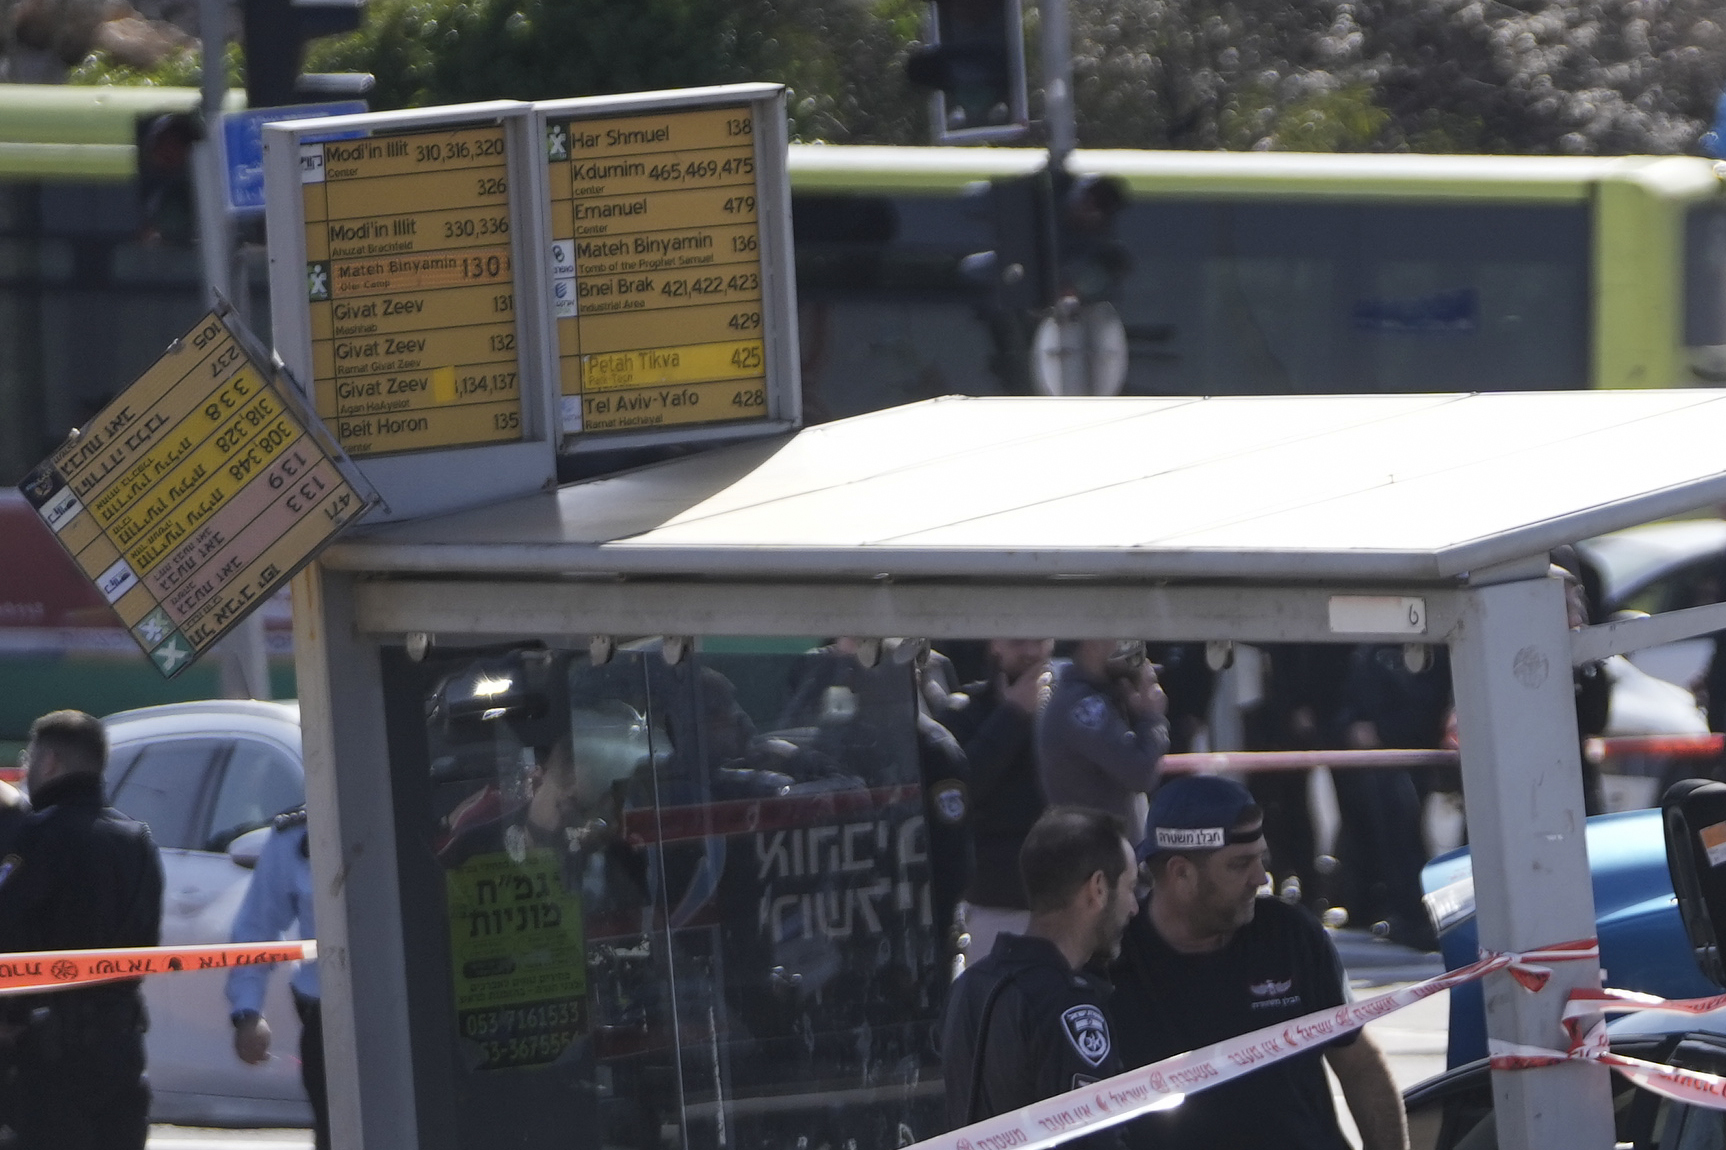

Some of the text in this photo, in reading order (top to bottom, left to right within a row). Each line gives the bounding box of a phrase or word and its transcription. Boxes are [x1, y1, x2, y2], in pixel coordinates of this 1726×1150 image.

[571, 117, 751, 149] Har Shmuel 138
[325, 143, 382, 163] Modi'in
[386, 140, 408, 157] Illit
[415, 138, 504, 164] 310,316,320
[573, 156, 753, 185] Kdumim 465,469,475
[477, 177, 506, 195] 326
[575, 195, 755, 220] Emanuel 479
[330, 216, 509, 241] Modi'in Illit 330,336
[577, 230, 756, 259] Mateh Binyamin 136
[339, 255, 500, 279] Mateh Binyamin 130
[579, 272, 758, 301] Bnei Brak 421,422,423
[334, 294, 512, 320] Givat Zeev 131
[728, 312, 760, 330] 429
[336, 333, 515, 359] Givat Zeev 132
[589, 345, 760, 374] Petah Tikva 425
[59, 320, 221, 477] גבעת זאב 105
[124, 408, 171, 453] בלבד
[206, 344, 240, 377] 237
[338, 375, 428, 399] Givat Zeev
[584, 388, 763, 415] Tel Aviv-Yafo 428
[340, 411, 518, 438] Beit Horon 135
[99, 472, 152, 521] מודיעין
[202, 376, 250, 423] 338
[116, 496, 168, 545] מודיעין
[210, 393, 274, 454] 318,328
[134, 520, 186, 569] מודיעין
[224, 417, 293, 483] 308,348
[158, 449, 308, 592] גבעת זאב 139
[175, 473, 327, 616] גבעת זאב 133
[187, 619, 216, 648] תל
[212, 584, 256, 624] אביב
[322, 490, 354, 520] 471
[1158, 831, 1194, 844] משטרה
[470, 904, 562, 938] מוניות
[1168, 1059, 1218, 1089] משטרת
